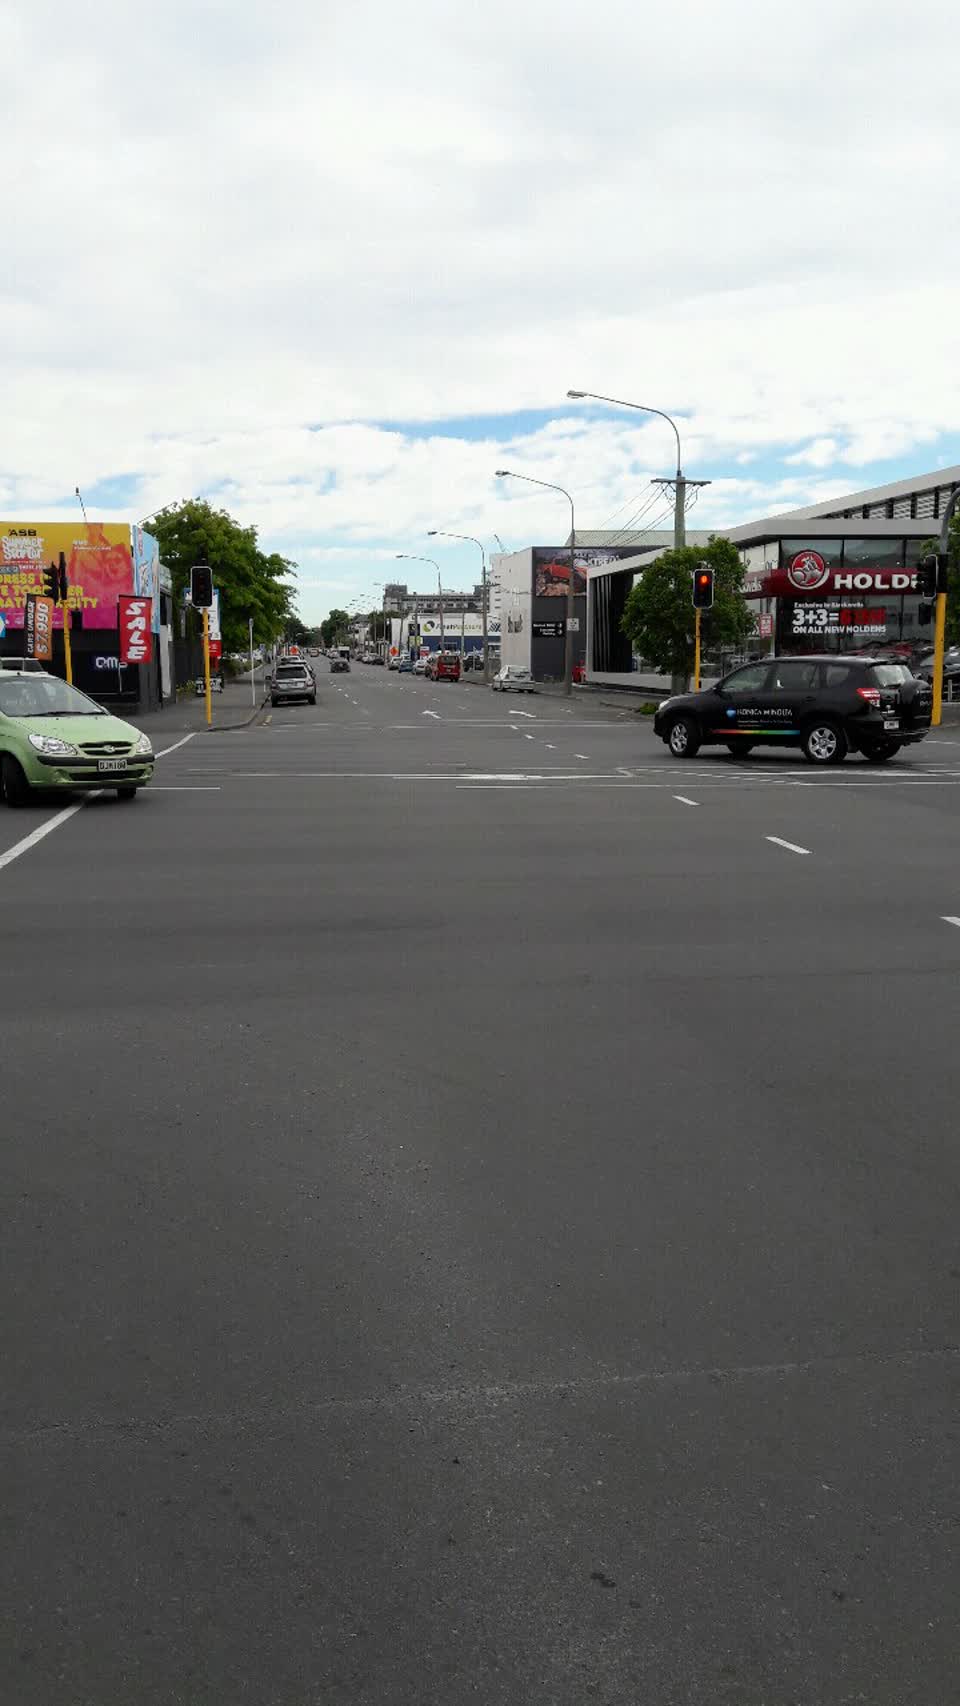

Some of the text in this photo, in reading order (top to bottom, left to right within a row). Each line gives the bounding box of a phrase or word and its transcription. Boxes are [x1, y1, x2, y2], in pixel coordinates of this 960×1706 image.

[833, 574, 918, 590] HOLD
[125, 602, 147, 660] SALE
[793, 625, 887, 634] ON ALL NEW HOLDENS
